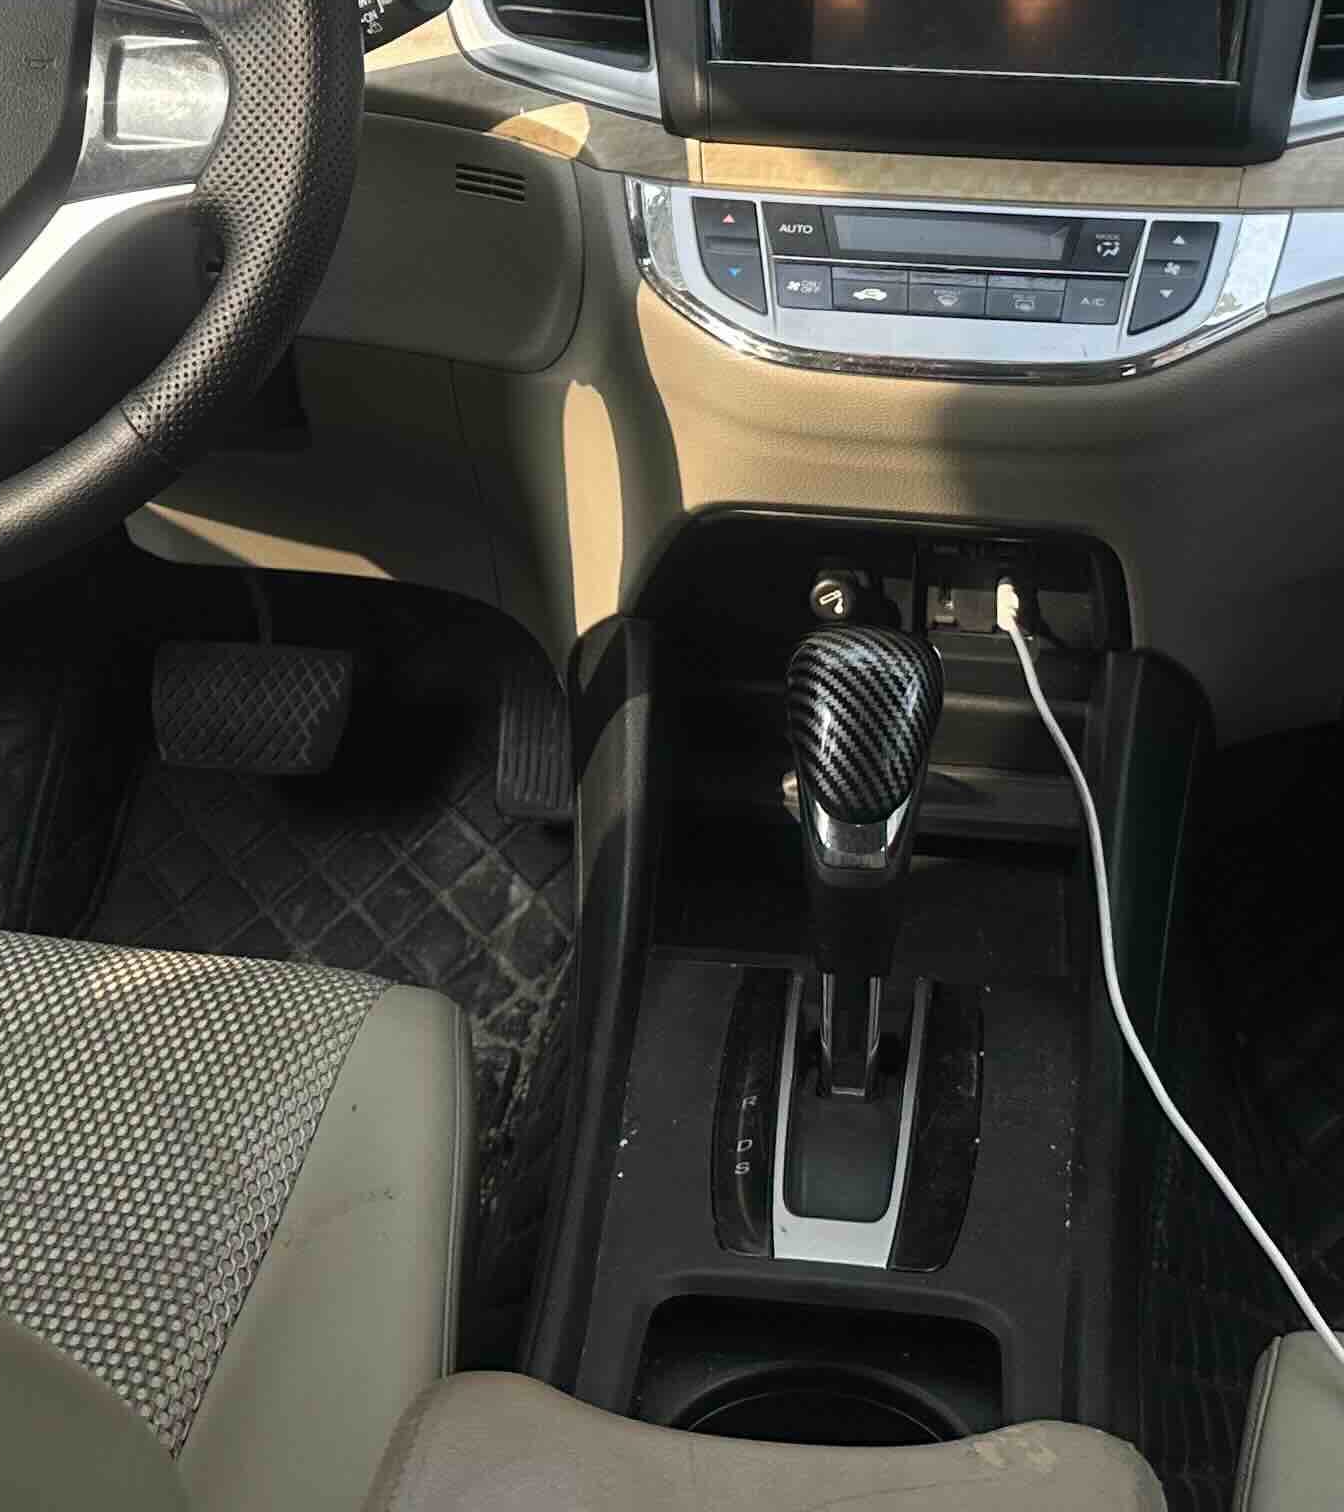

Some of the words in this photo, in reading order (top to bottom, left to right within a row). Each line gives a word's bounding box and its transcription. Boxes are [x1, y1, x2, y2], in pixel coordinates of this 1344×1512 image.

[779, 223, 813, 235] AUTO
[1080, 296, 1105, 306] A/C
[737, 1139, 753, 1152] D
[735, 1161, 751, 1175] S
